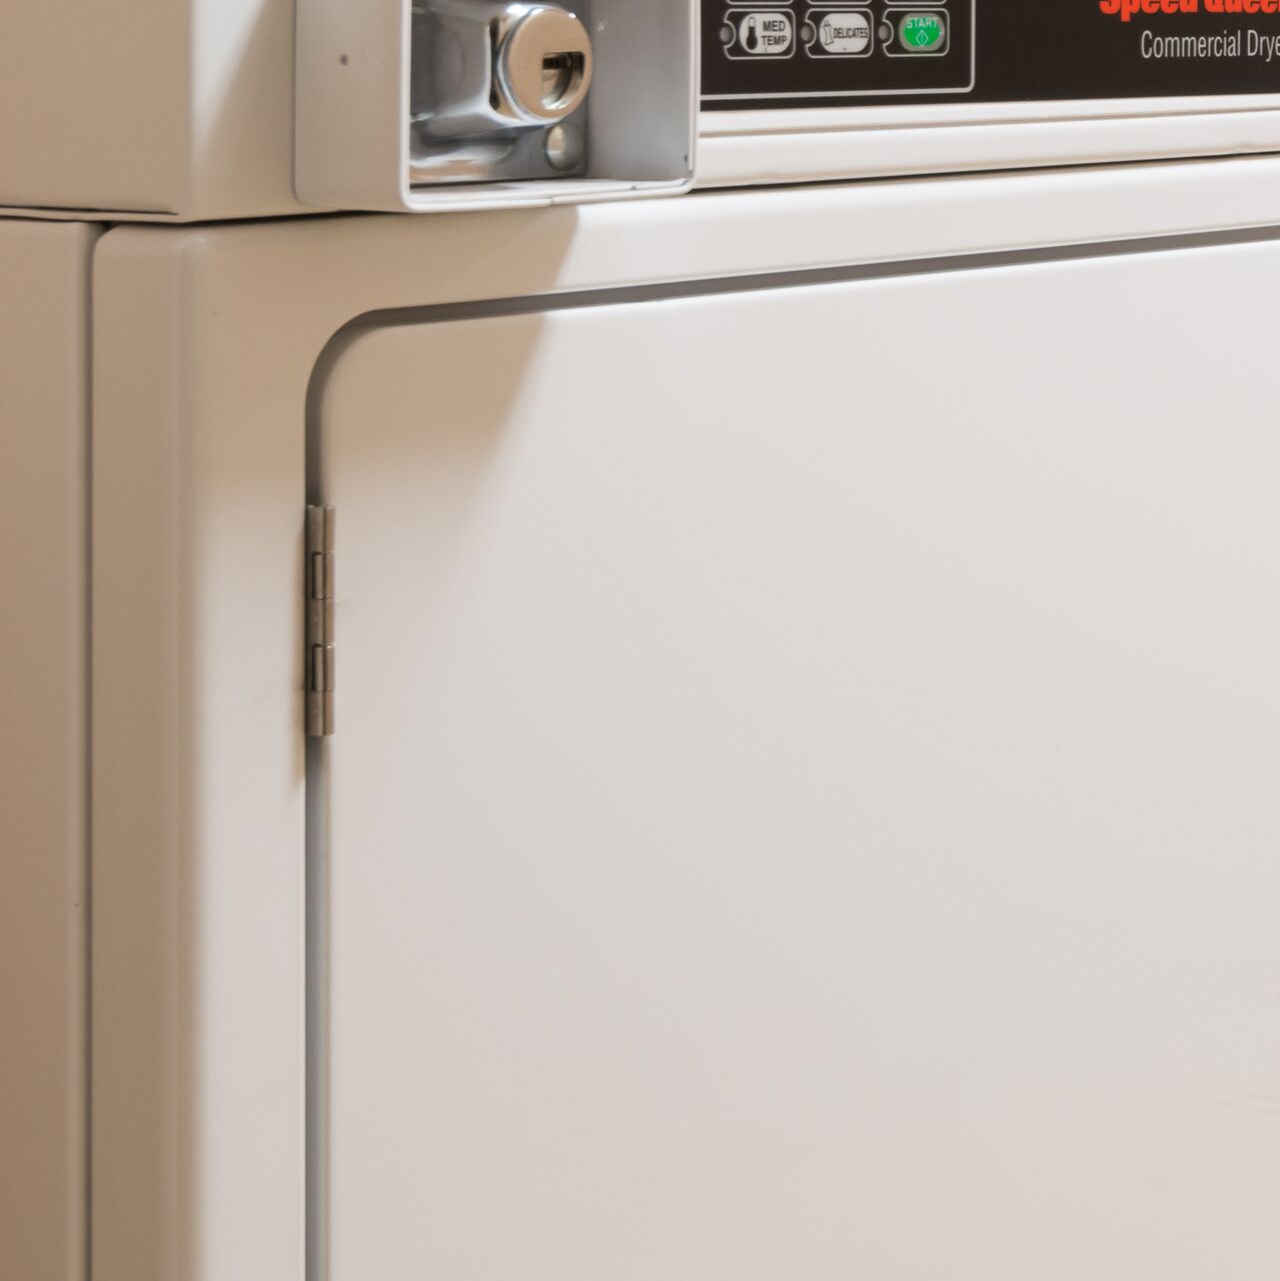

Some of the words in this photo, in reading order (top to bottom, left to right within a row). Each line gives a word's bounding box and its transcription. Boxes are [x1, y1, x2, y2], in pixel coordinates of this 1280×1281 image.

[762, 20, 786, 32] MED
[905, 17, 938, 29] START
[833, 27, 869, 39] DELICATES
[761, 35, 788, 46] TEMP
[1140, 29, 1242, 59] Commercial
